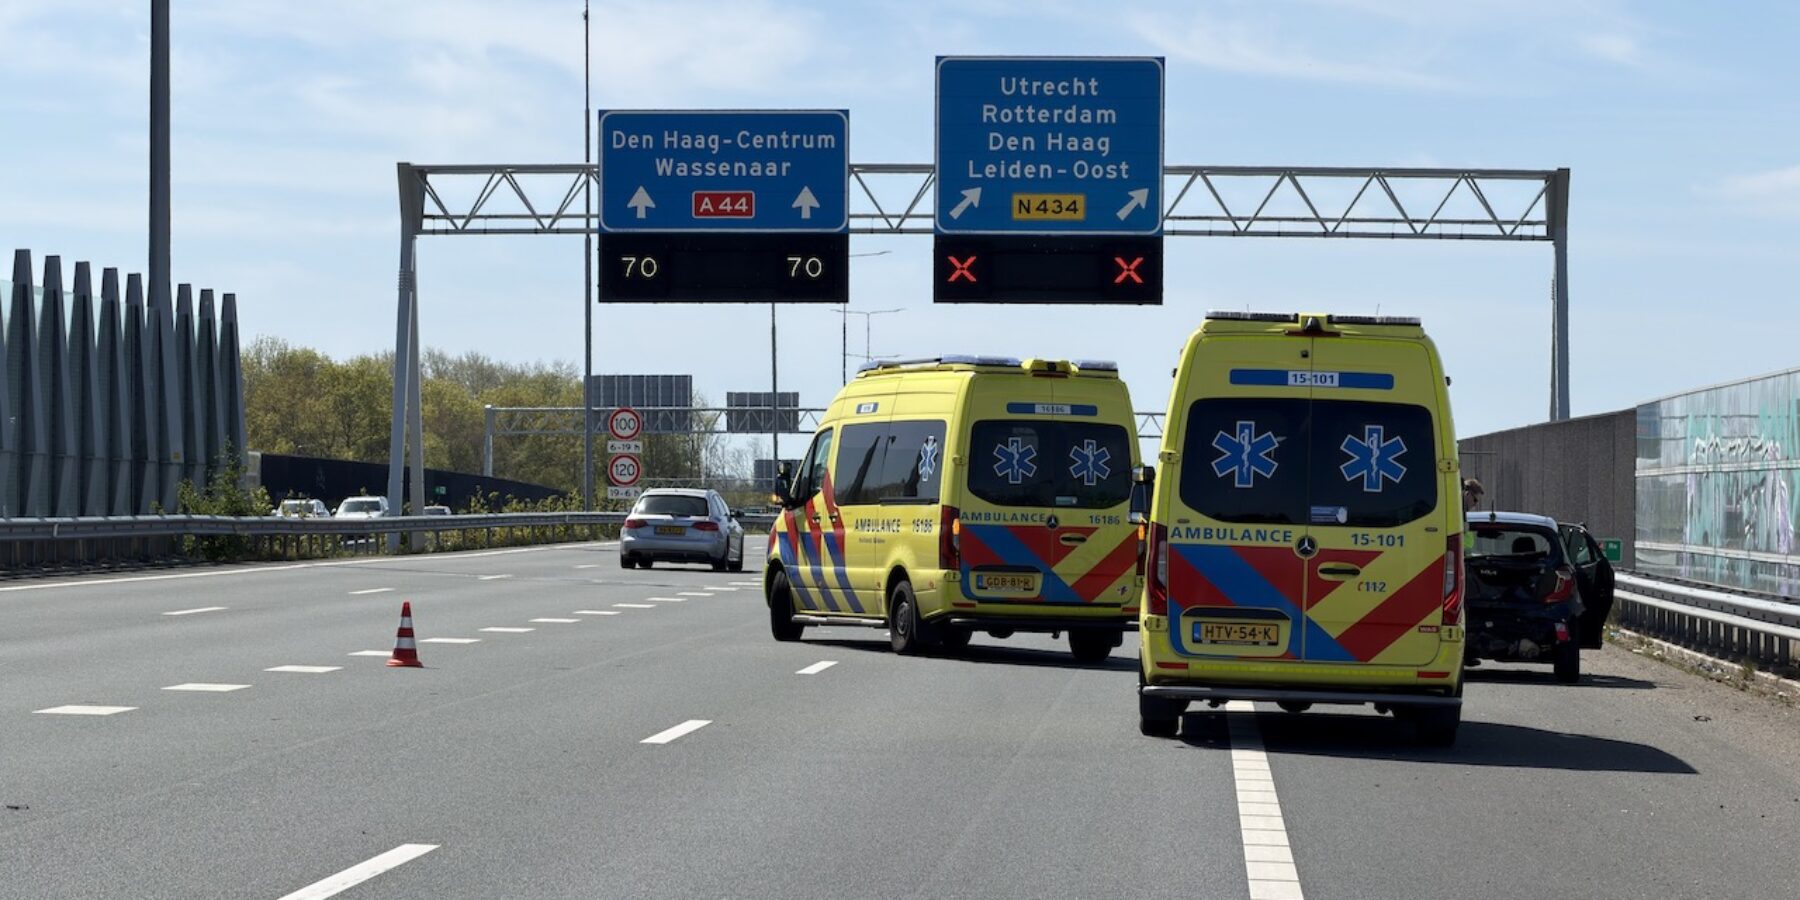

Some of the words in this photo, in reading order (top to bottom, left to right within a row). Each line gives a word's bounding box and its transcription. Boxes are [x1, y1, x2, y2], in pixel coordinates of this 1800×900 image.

[1000, 77, 1099, 96] Utrecht
[982, 104, 1117, 124] Rotterdam
[612, 130, 654, 150] Den
[664, 130, 836, 154] Haag-Centrum
[988, 132, 1036, 152] Den
[1047, 132, 1111, 157] Haag
[655, 158, 791, 177] Wassenaar
[968, 160, 1130, 180] Leiden-Oost
[1018, 199, 1079, 215] N434
[621, 256, 658, 278] 70
[786, 256, 823, 278] 70
[1292, 373, 1334, 385] 15-101
[1041, 405, 1065, 413] 16186
[615, 417, 636, 431] 100
[609, 443, 631, 451] 6-19
[615, 463, 635, 477] 120
[609, 489, 631, 497] 19-6
[961, 512, 1046, 522] AMBULANCE
[1089, 514, 1120, 525] 16186
[855, 518, 901, 533] AMBULANCE
[912, 518, 933, 533] 16186
[1170, 526, 1293, 543] AMBULANCE
[1350, 532, 1405, 548] 15-101
[986, 577, 1031, 587] GDB-81-R
[1364, 581, 1387, 593] 112
[1204, 625, 1272, 641] HTV-54-K
